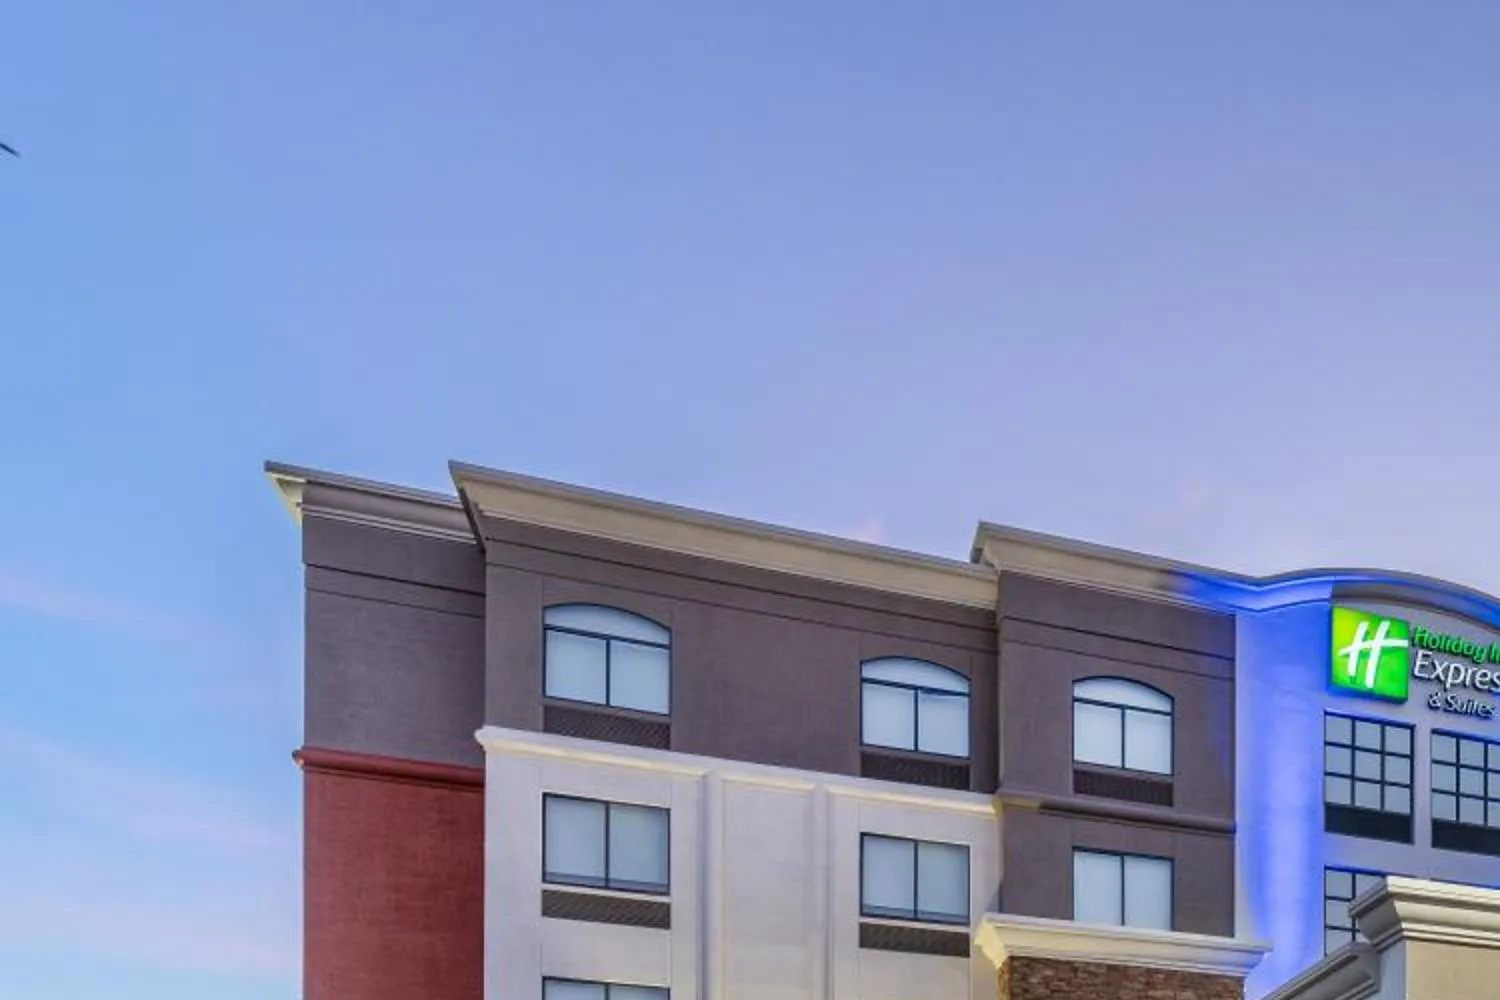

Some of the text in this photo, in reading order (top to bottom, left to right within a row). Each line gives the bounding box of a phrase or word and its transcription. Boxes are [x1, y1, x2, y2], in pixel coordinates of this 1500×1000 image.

[1413, 627, 1487, 663] Holiday
[1428, 692, 1496, 718] & Suites
